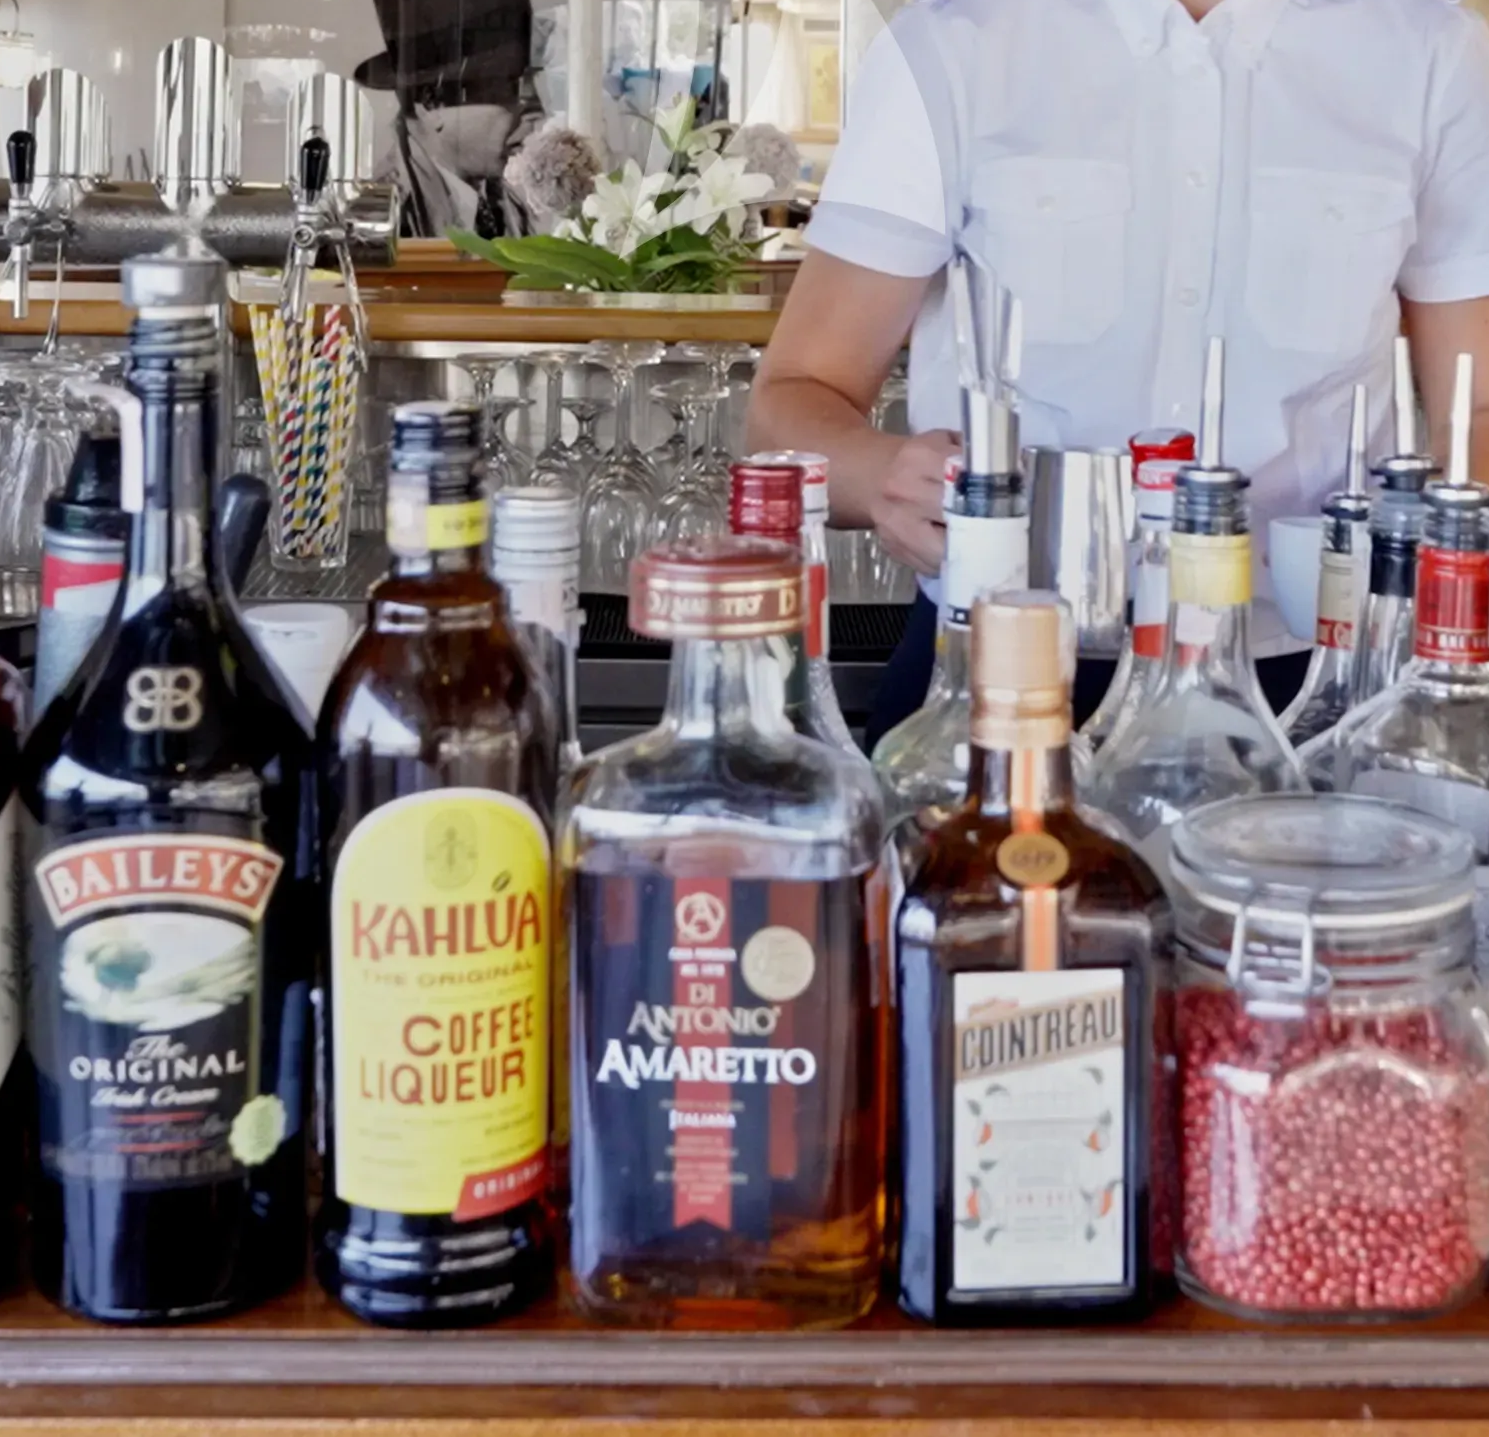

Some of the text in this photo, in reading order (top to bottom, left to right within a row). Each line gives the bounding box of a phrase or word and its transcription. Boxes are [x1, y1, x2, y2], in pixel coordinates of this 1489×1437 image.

[49, 849, 268, 906] BAILEYS
[688, 983, 716, 1004] DI
[125, 1034, 189, 1061] The
[401, 994, 544, 1057] COFFEE
[962, 995, 1117, 1072] COINTREAU
[69, 1049, 246, 1084] ORIGINAL
[360, 1048, 526, 1106] LIQUEUR
[596, 1038, 817, 1090] AMARETTO
